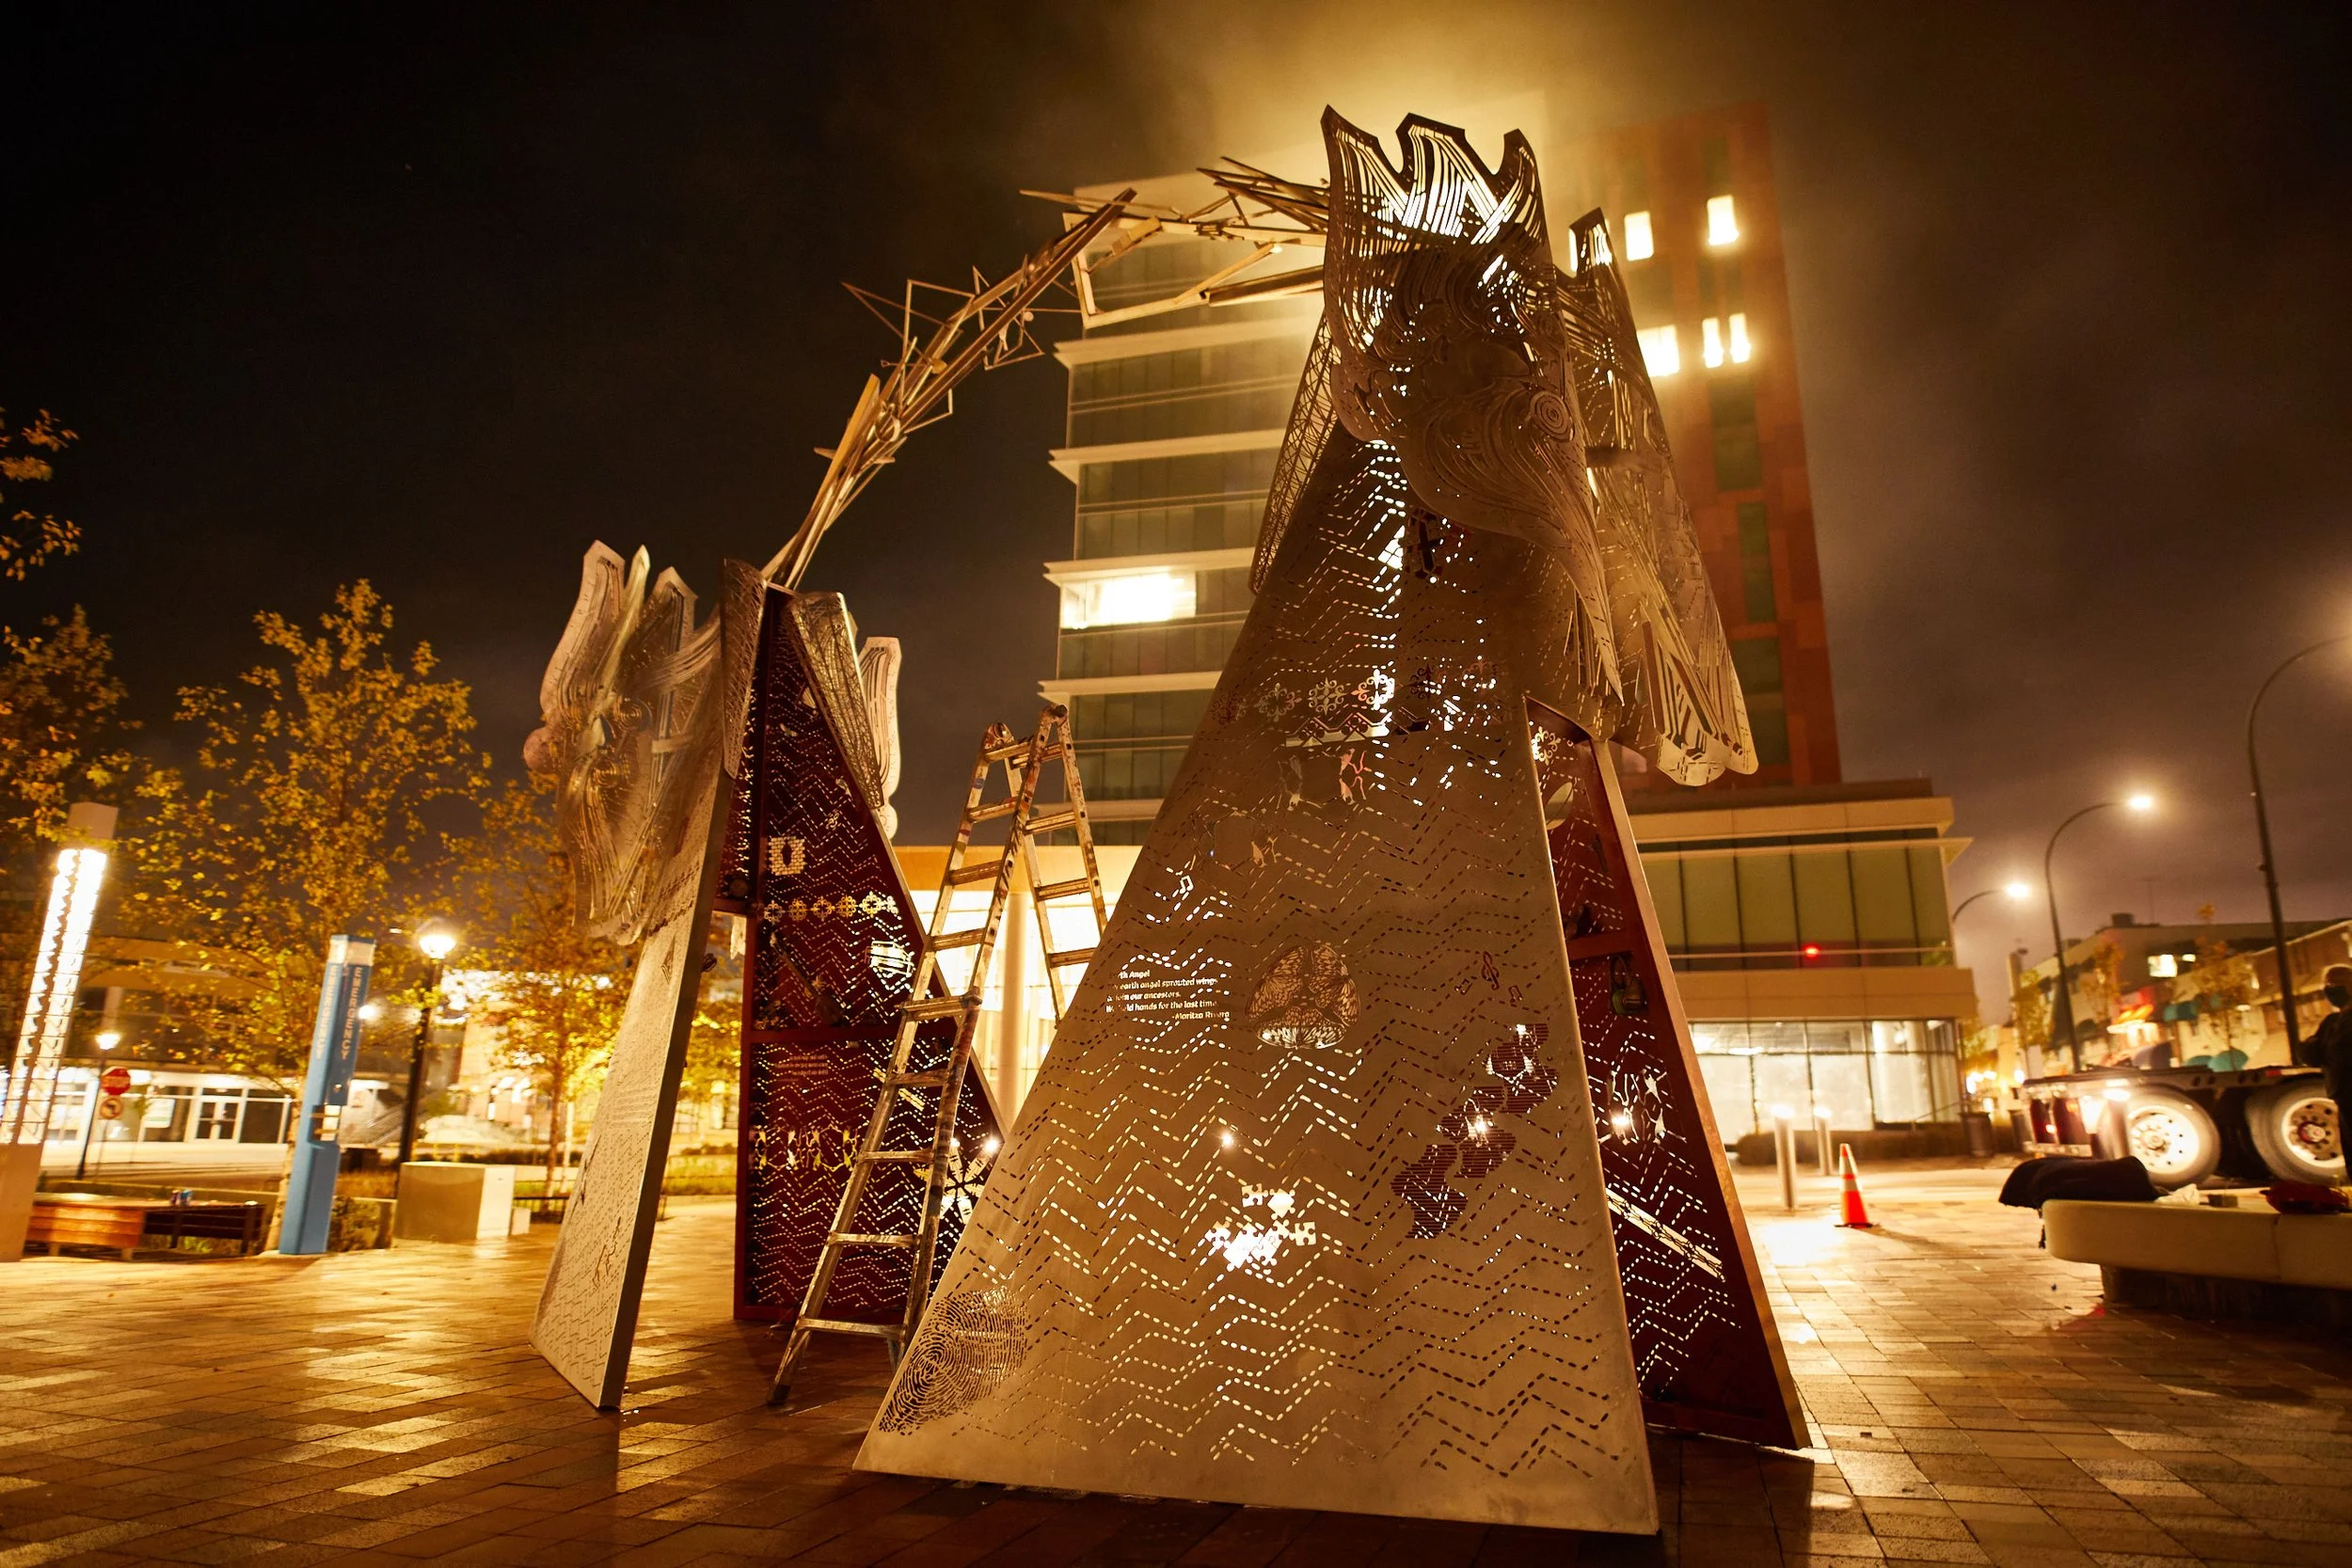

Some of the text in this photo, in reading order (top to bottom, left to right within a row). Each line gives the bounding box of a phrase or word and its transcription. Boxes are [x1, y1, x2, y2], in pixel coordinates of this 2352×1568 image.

[1129, 969, 1151, 979] Angel
[1120, 981, 1139, 990] earth
[1139, 979, 1161, 989] angel
[1161, 977, 1195, 988] sprouted
[1143, 991, 1182, 1000] ancestors.
[1135, 1002, 1158, 1011] hands
[1158, 1001, 1169, 1010] for
[1170, 1001, 1184, 1009] the
[1184, 1000, 1199, 1008] last
[341, 966, 362, 1060] EMERGENCY
